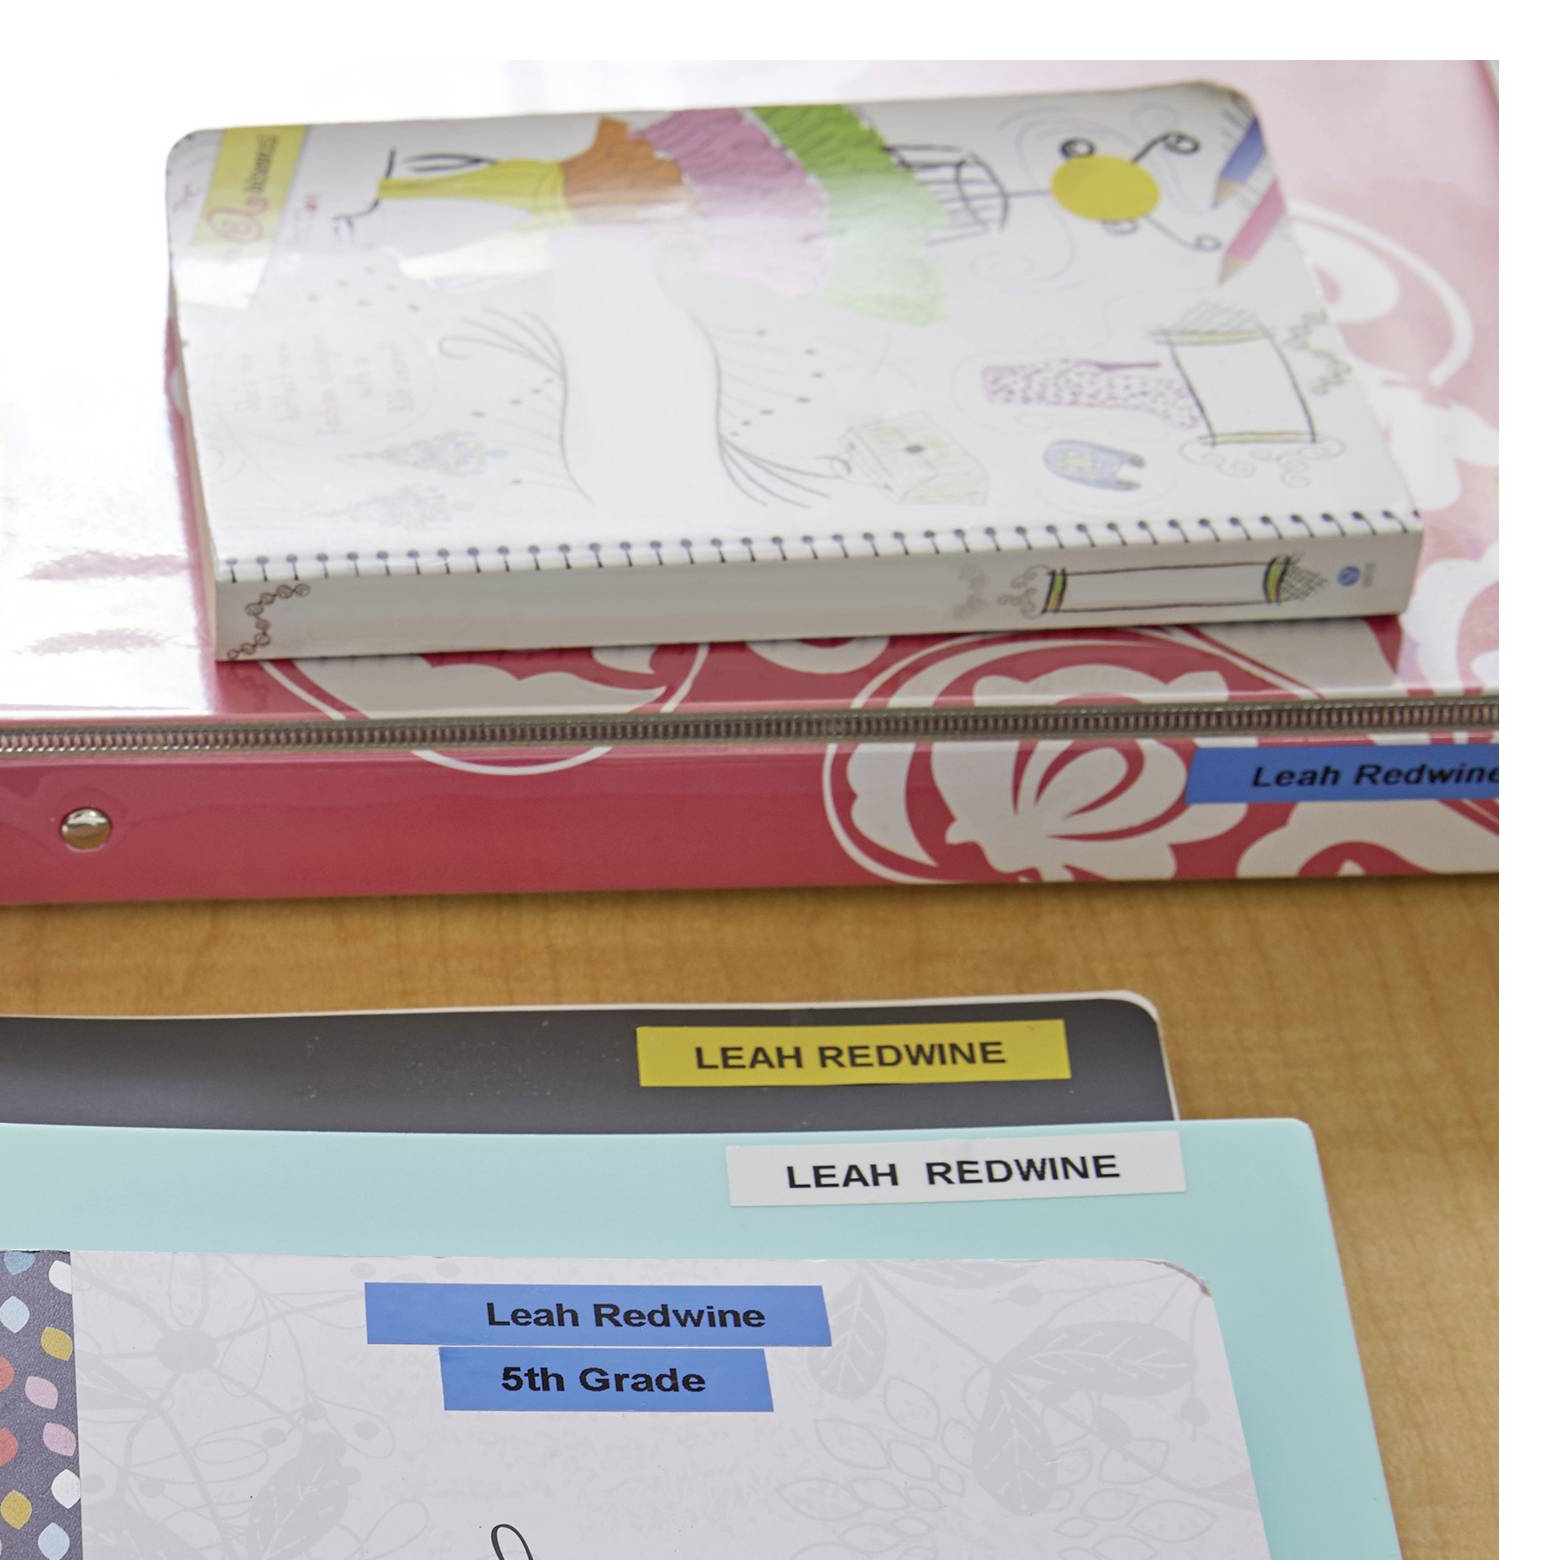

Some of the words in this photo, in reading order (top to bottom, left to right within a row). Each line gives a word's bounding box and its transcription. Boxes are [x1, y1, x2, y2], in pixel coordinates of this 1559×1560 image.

[1253, 764, 1341, 788] Leah
[694, 1045, 803, 1071] LEAH
[817, 1040, 1007, 1069] REDWINE
[786, 1162, 899, 1190] LEAH
[924, 1153, 1121, 1186] REDWINE
[485, 1301, 580, 1328] Leah
[593, 1303, 767, 1329] Redwine
[501, 1365, 566, 1392] 5th
[579, 1367, 707, 1393] Grade
